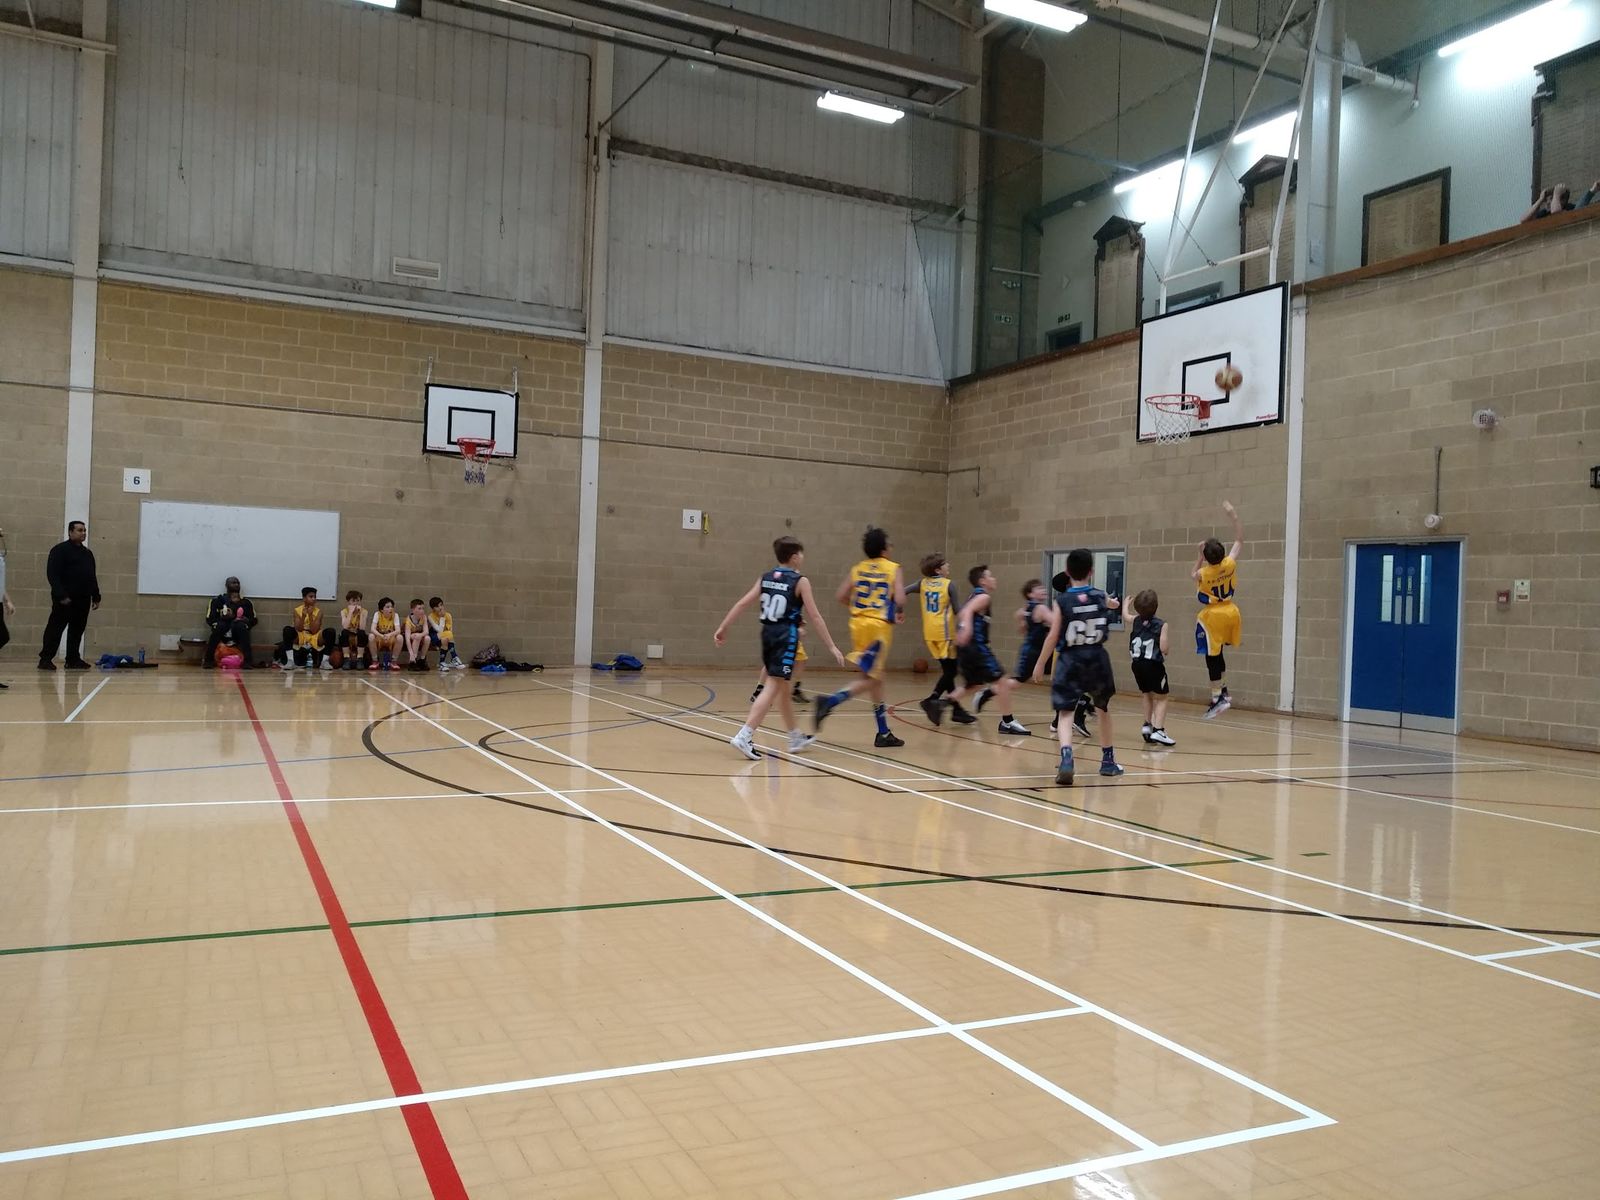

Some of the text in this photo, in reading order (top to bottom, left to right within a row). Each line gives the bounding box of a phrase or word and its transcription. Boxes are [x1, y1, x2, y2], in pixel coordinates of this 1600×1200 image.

[133, 476, 141, 486] 6
[689, 515, 695, 524] 5
[854, 580, 889, 609] 23
[925, 591, 940, 613] 13
[759, 593, 788, 622] 30
[1065, 617, 1107, 647] 65
[1130, 636, 1155, 660] 31
